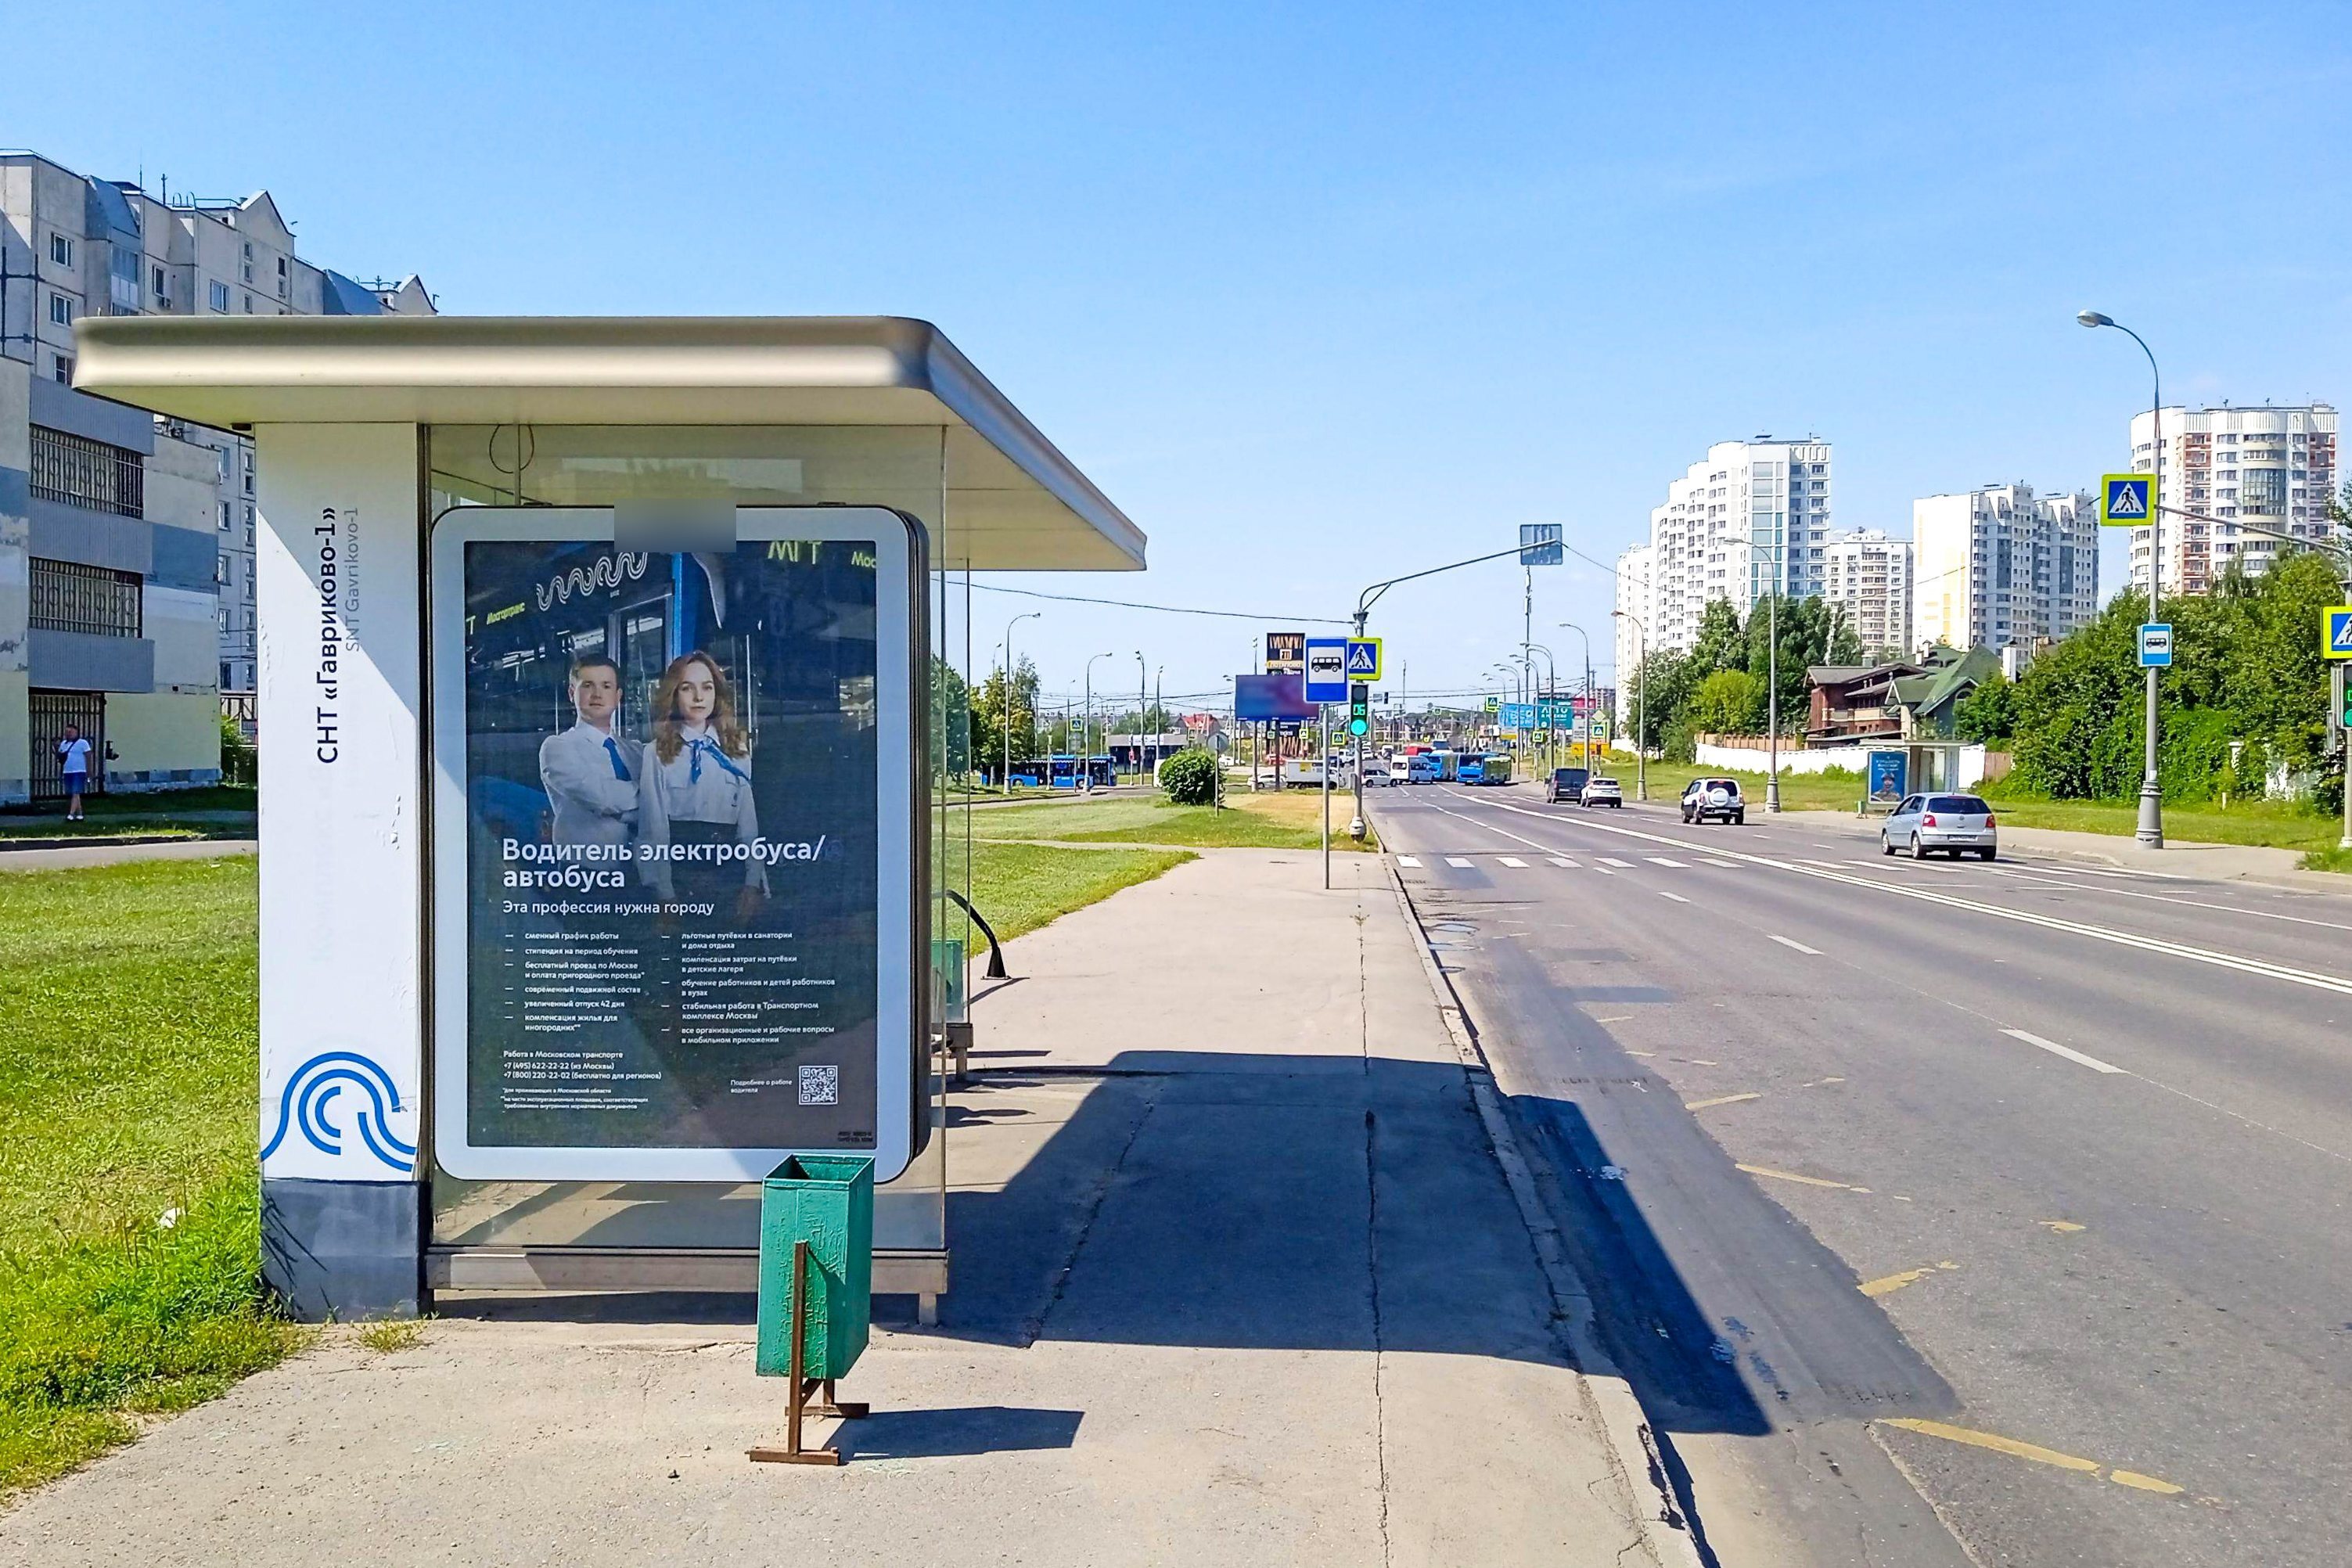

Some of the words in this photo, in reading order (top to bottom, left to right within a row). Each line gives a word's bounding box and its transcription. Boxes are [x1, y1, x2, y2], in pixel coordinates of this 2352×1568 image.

[344, 507, 359, 612] Gavrikovo-1
[315, 507, 341, 699] «Гавриково-1»
[346, 616, 360, 651] SNT
[317, 707, 337, 763] СНТ
[502, 837, 632, 864] Водитель
[639, 836, 825, 865] электробуса/
[502, 865, 624, 890] автобуса
[503, 901, 528, 913] Эта
[532, 901, 610, 915] профессия
[615, 903, 660, 916] нужна
[664, 903, 714, 916] городу
[768, 955, 797, 964] путёвки
